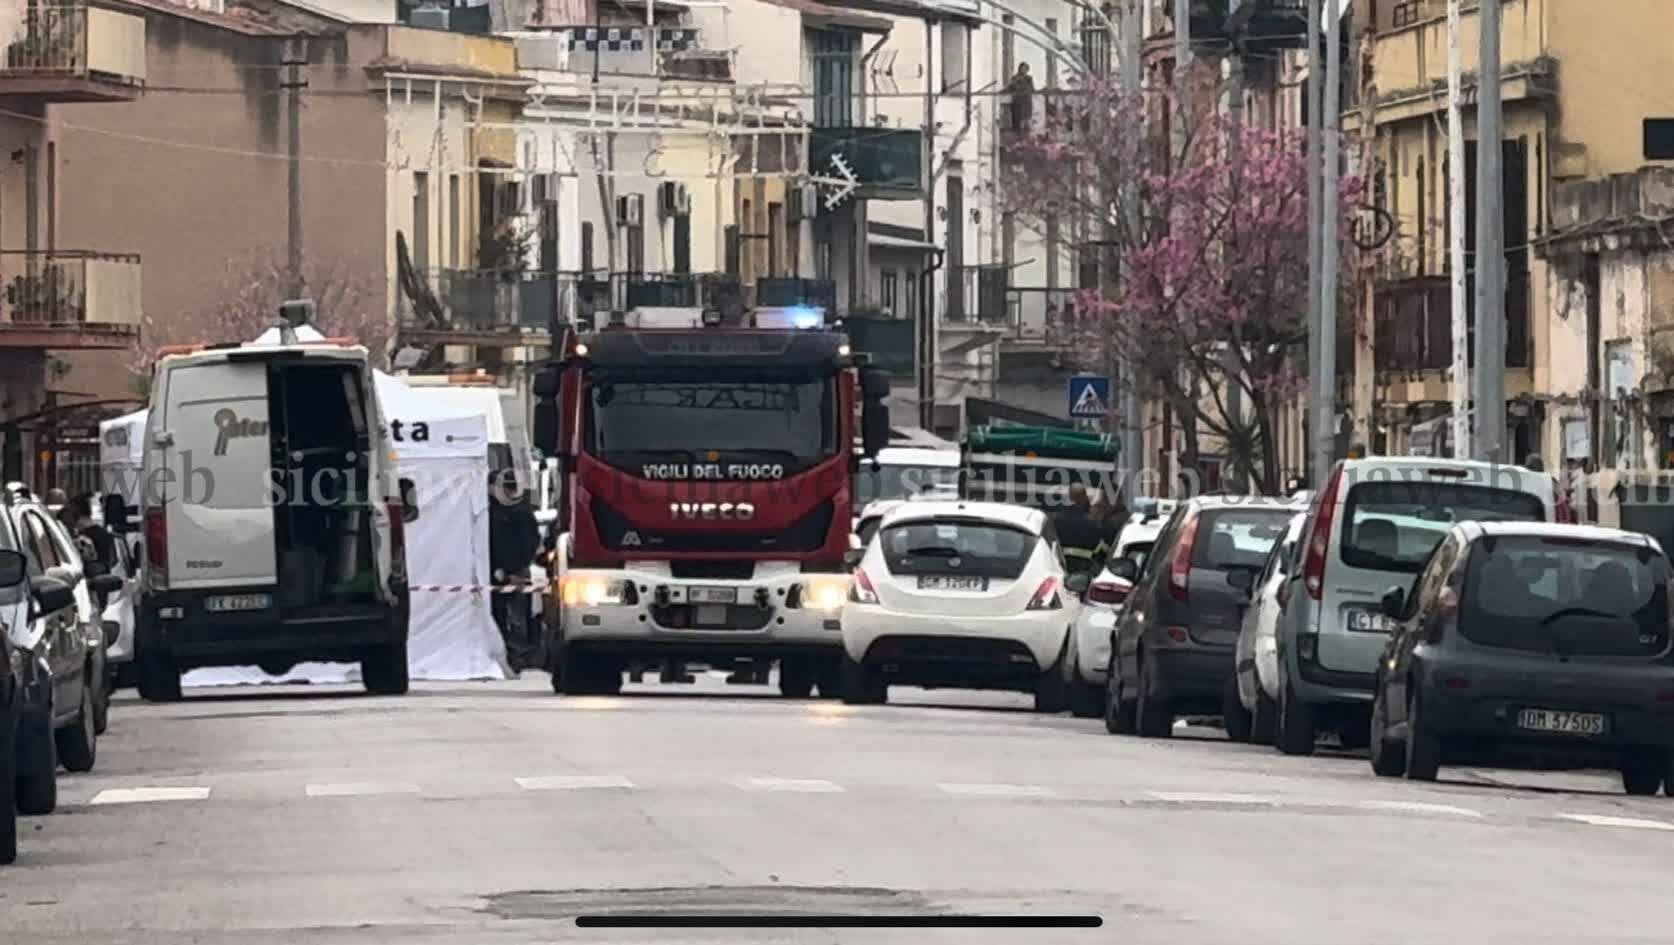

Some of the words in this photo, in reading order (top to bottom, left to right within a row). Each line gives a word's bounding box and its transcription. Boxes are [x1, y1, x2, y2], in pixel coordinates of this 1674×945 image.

[643, 464, 688, 479] VIGILI
[695, 464, 724, 479] DEL
[727, 464, 784, 479] FUOCO
[670, 502, 755, 520] IVECO
